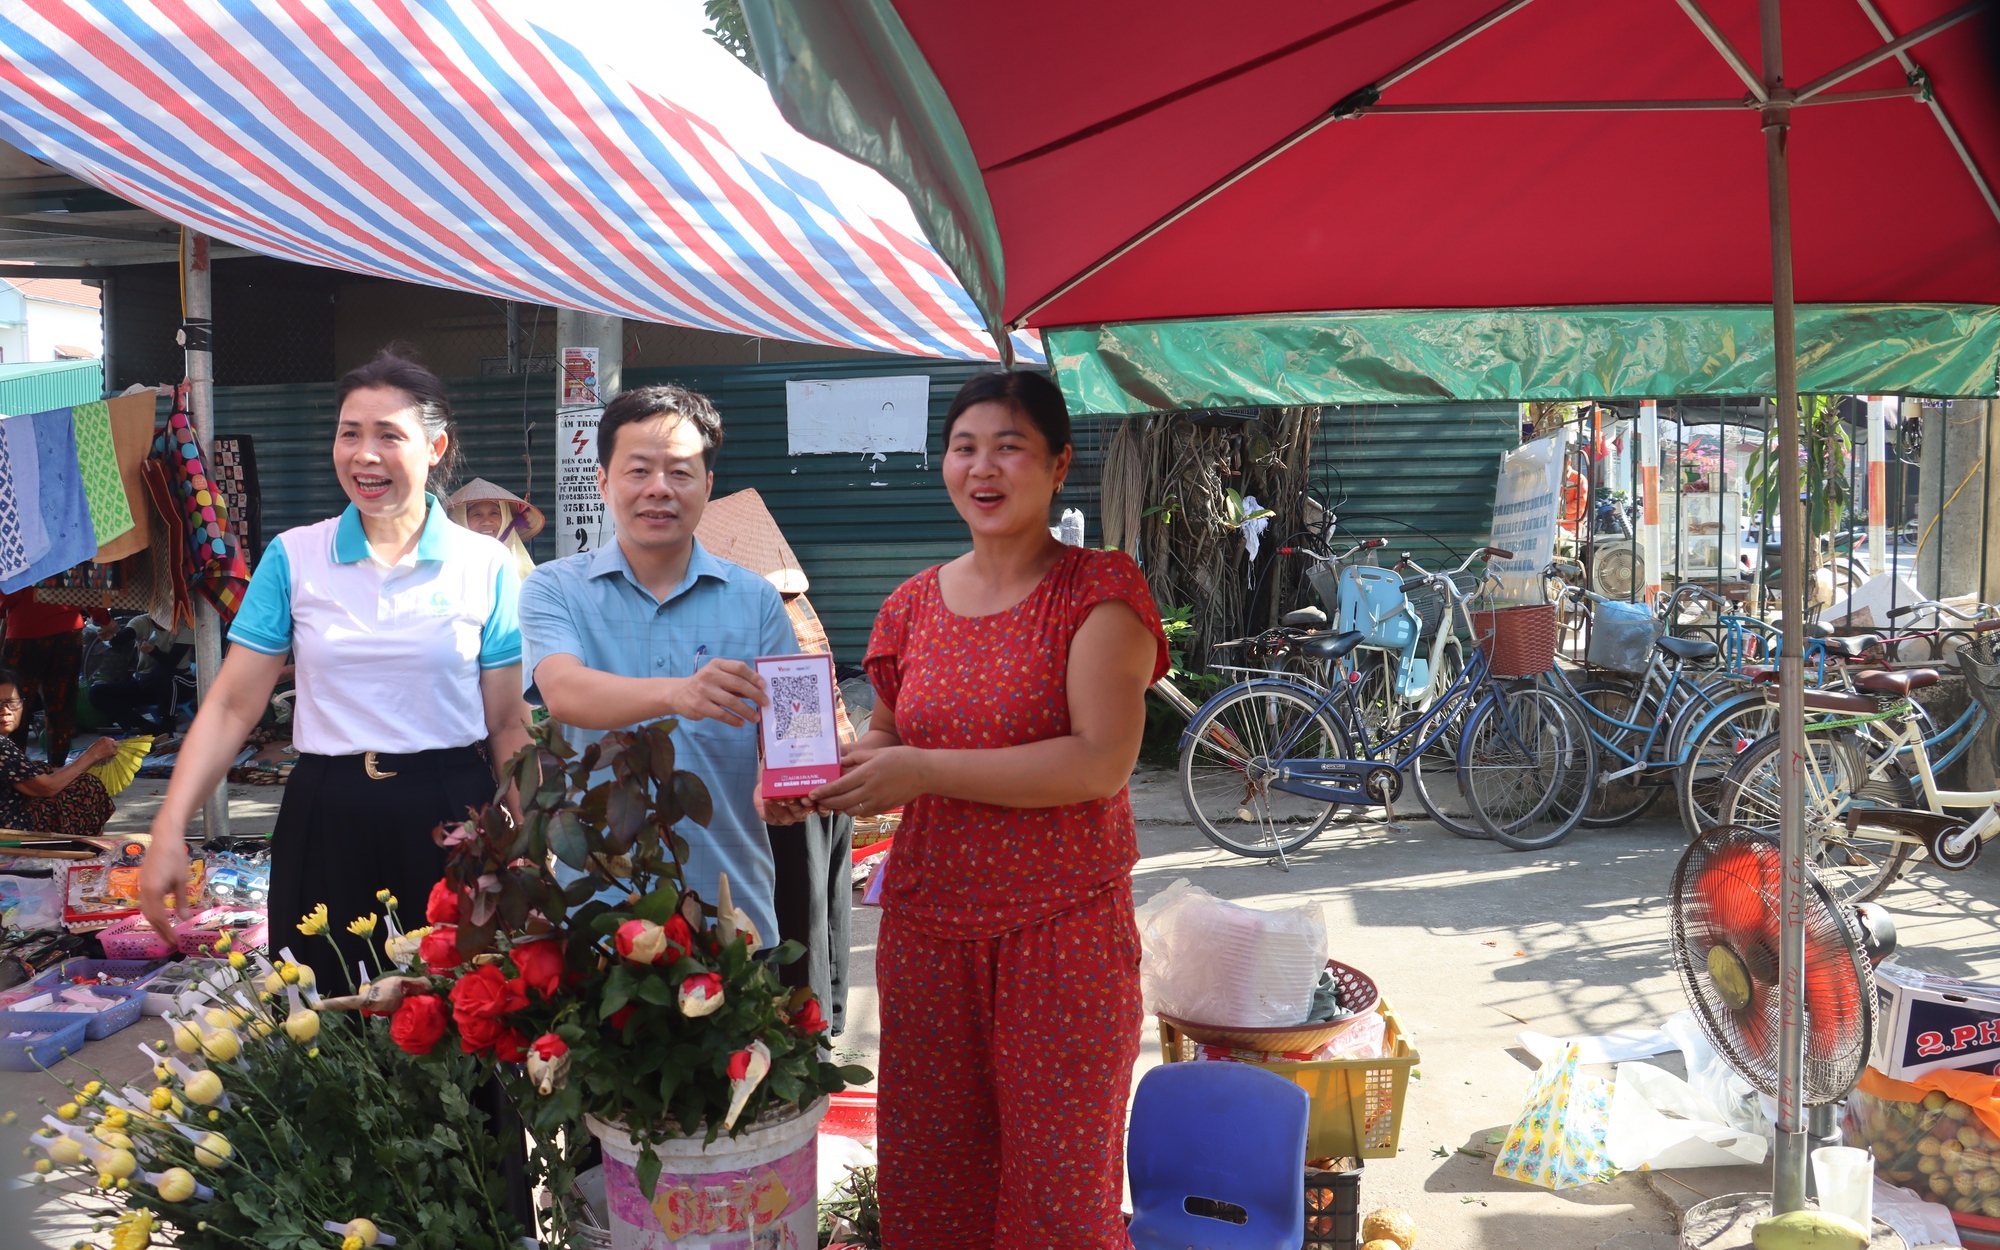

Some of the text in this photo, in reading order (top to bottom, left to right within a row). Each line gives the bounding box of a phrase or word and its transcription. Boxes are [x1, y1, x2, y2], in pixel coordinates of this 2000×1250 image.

[583, 464, 598, 472] HIỂ
[564, 502, 605, 512] 375E1.58
[566, 516, 574, 526] B.
[577, 514, 594, 525] BÌM
[576, 528, 590, 553] 2
